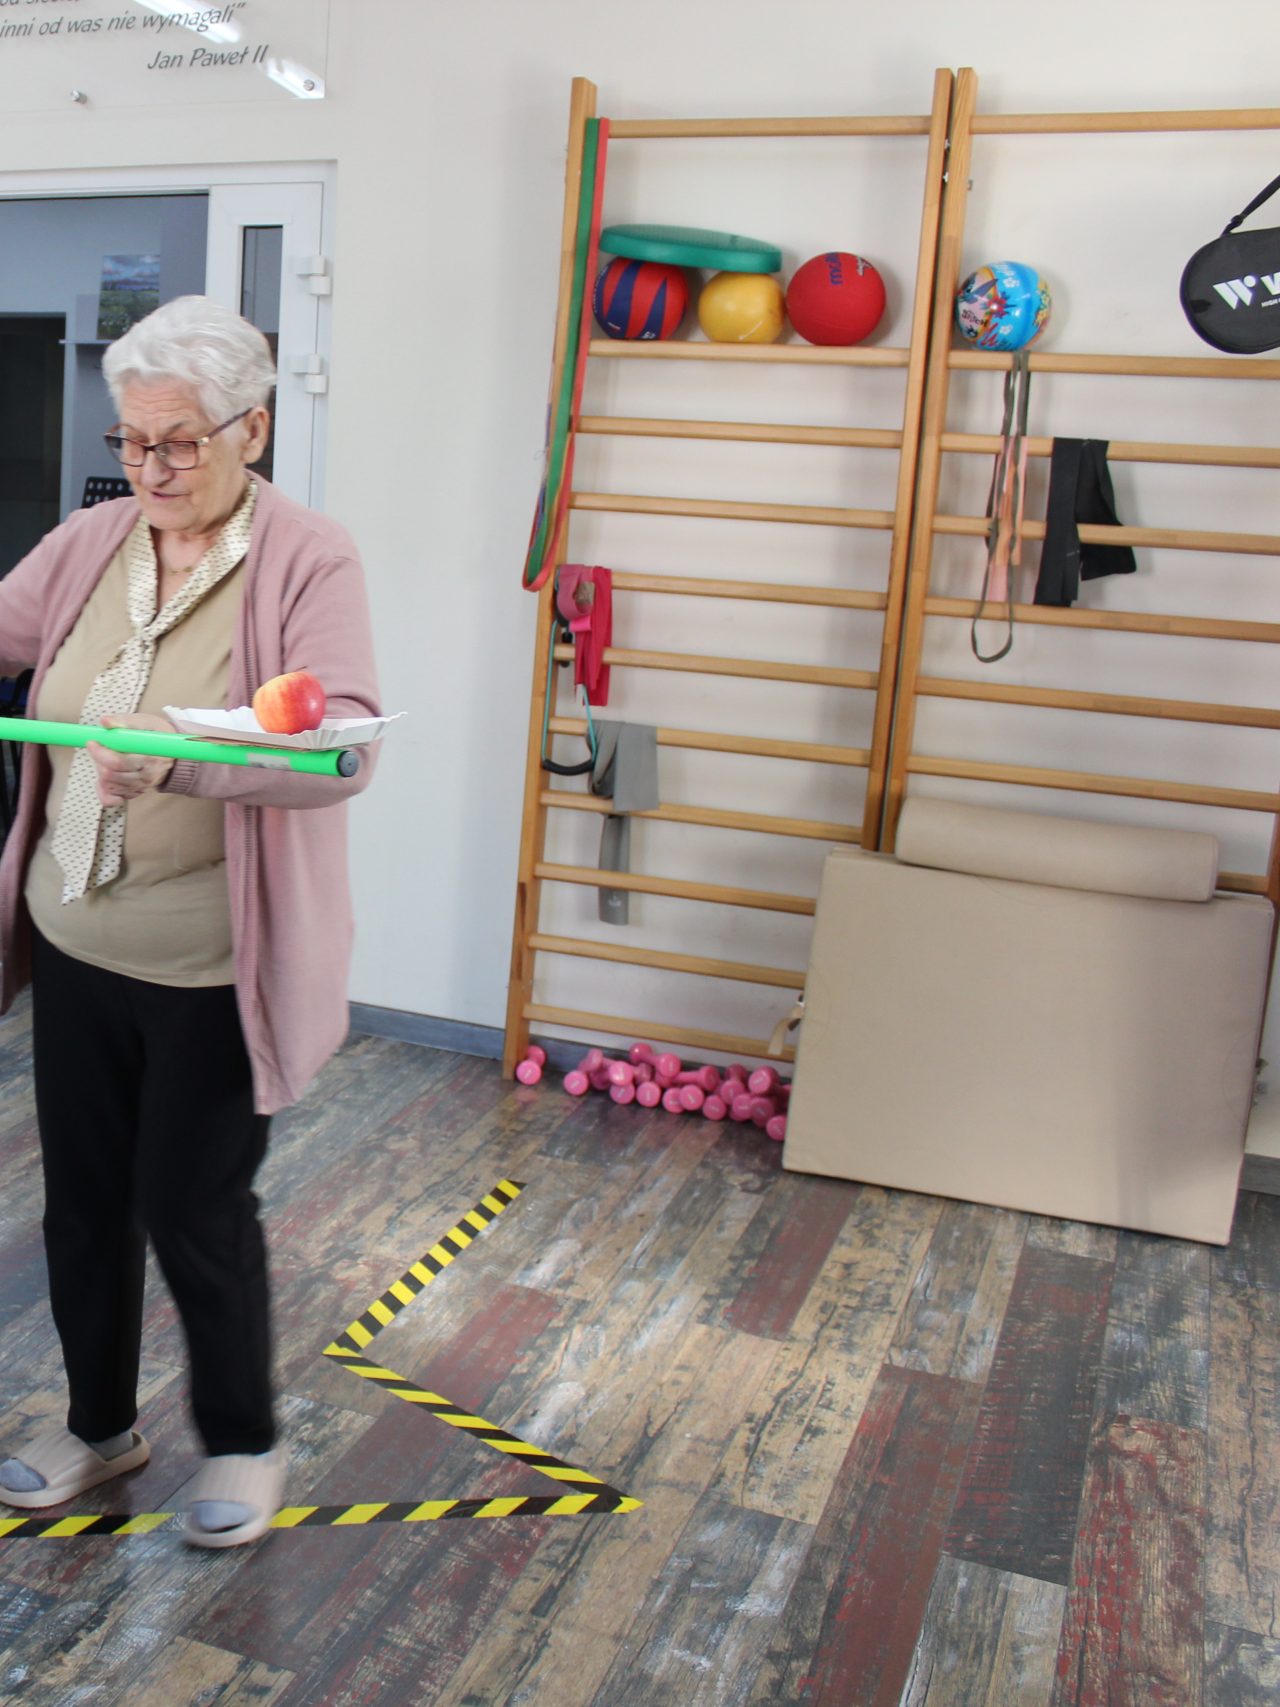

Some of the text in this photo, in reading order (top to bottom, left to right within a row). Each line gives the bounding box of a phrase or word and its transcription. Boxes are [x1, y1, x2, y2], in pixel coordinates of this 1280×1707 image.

[0, 17, 36, 38] inni
[38, 16, 64, 36] od
[66, 18, 103, 34] was
[107, 10, 136, 31] nie
[147, 44, 269, 69] Jan Paweł II
